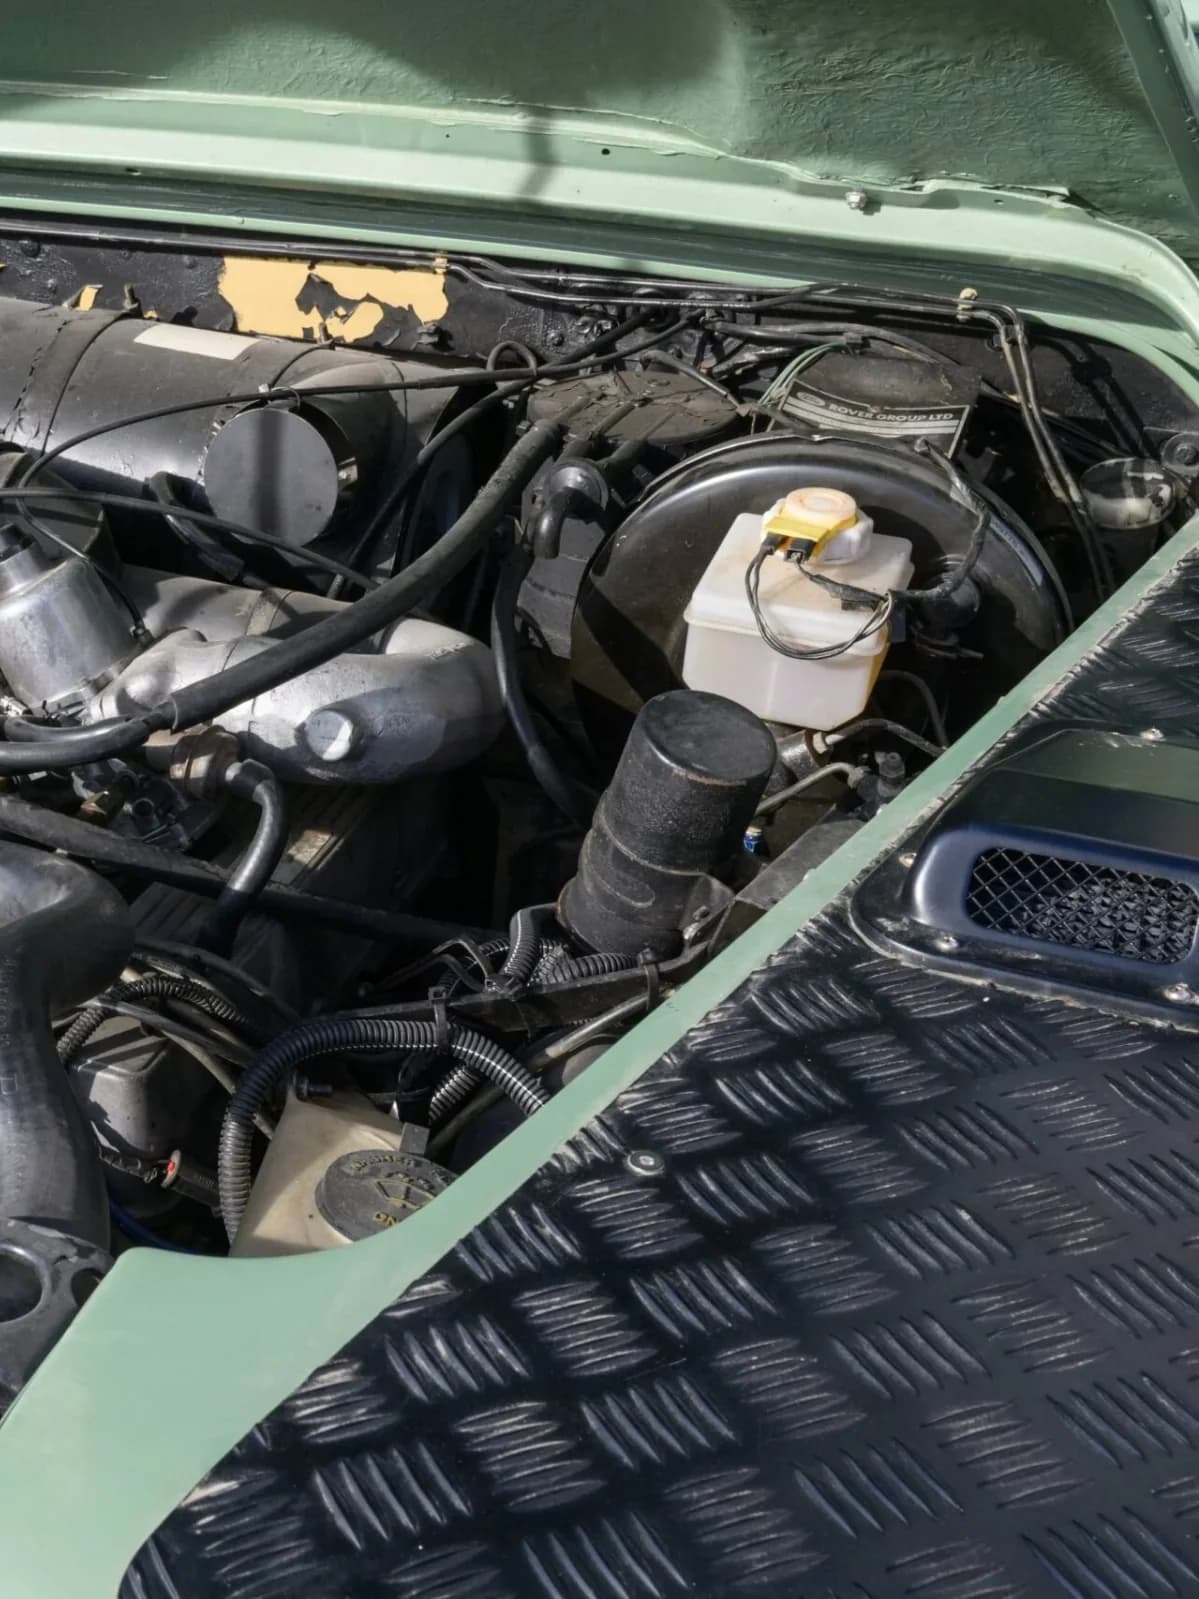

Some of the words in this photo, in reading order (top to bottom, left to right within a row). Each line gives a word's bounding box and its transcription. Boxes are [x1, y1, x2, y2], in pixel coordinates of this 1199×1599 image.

[829, 403, 874, 420] ROVER
[876, 411, 928, 422] GROUP
[928, 412, 954, 421] LTD
